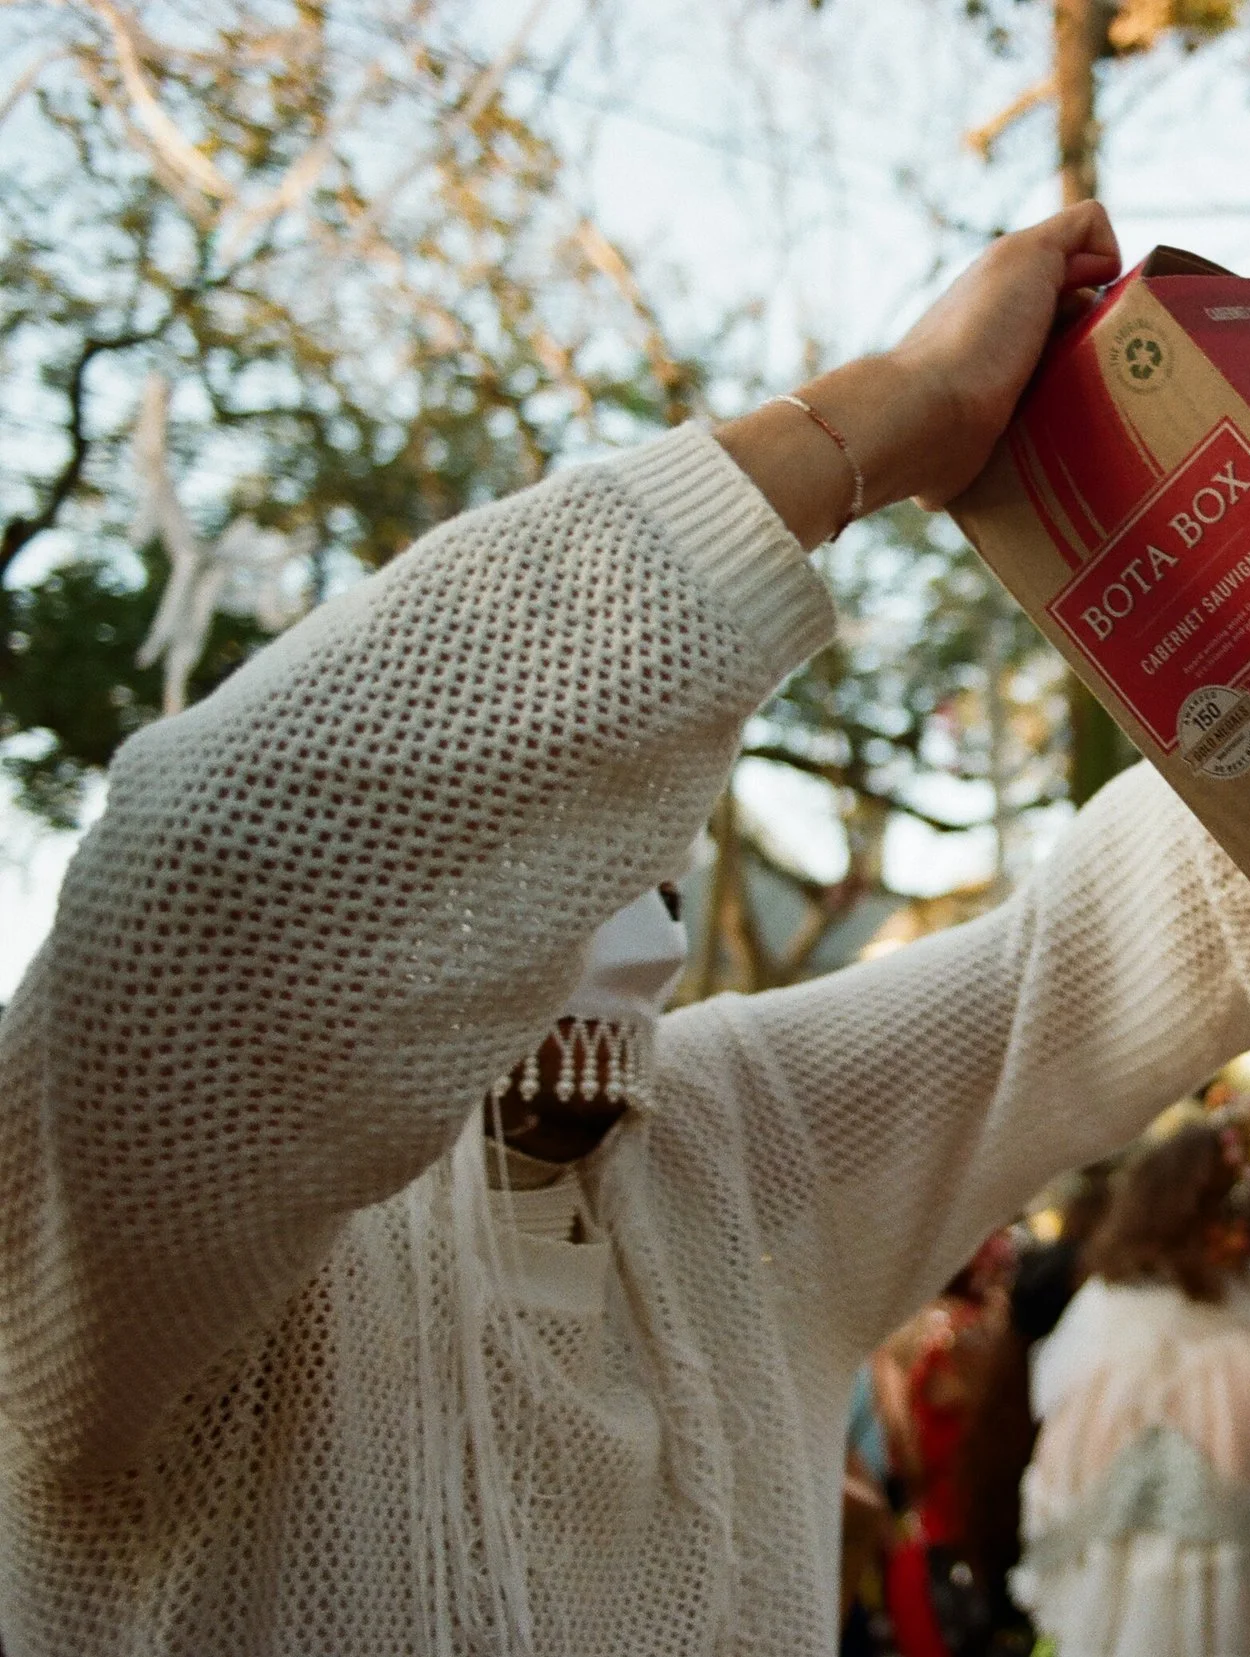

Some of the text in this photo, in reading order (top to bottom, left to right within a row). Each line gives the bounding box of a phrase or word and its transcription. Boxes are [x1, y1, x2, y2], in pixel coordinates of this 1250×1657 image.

[1080, 544, 1179, 641] BOTA
[1140, 607, 1205, 675] CABERNET
[1192, 702, 1222, 732] 150
[1193, 737, 1218, 762] GOLD
[1213, 705, 1250, 739] MEDALS
